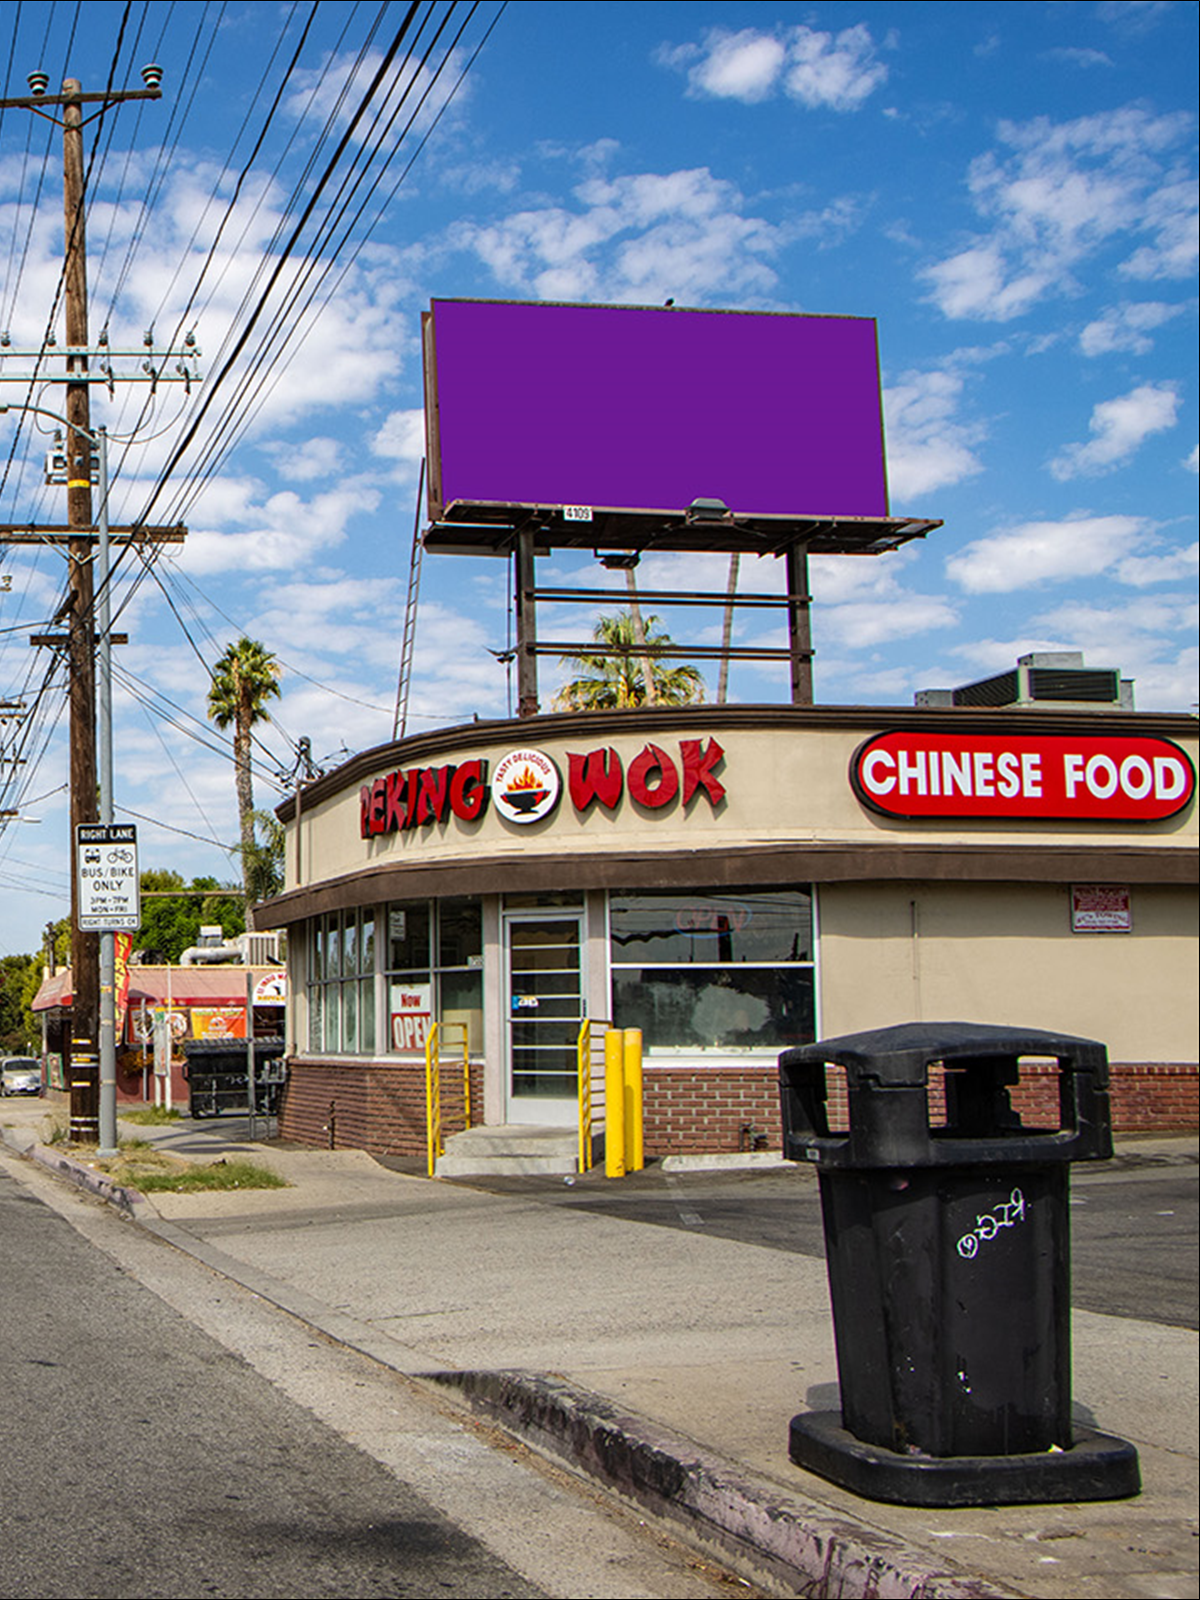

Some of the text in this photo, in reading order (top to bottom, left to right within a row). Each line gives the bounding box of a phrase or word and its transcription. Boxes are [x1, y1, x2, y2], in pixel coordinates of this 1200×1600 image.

[495, 753, 551, 782] TASTY DELICIOUS
[862, 749, 1186, 800] CHINESE FOOD
[360, 736, 726, 839] PEKING WOK
[80, 827, 134, 840] RIGHT LANE
[93, 880, 124, 891] ONLY
